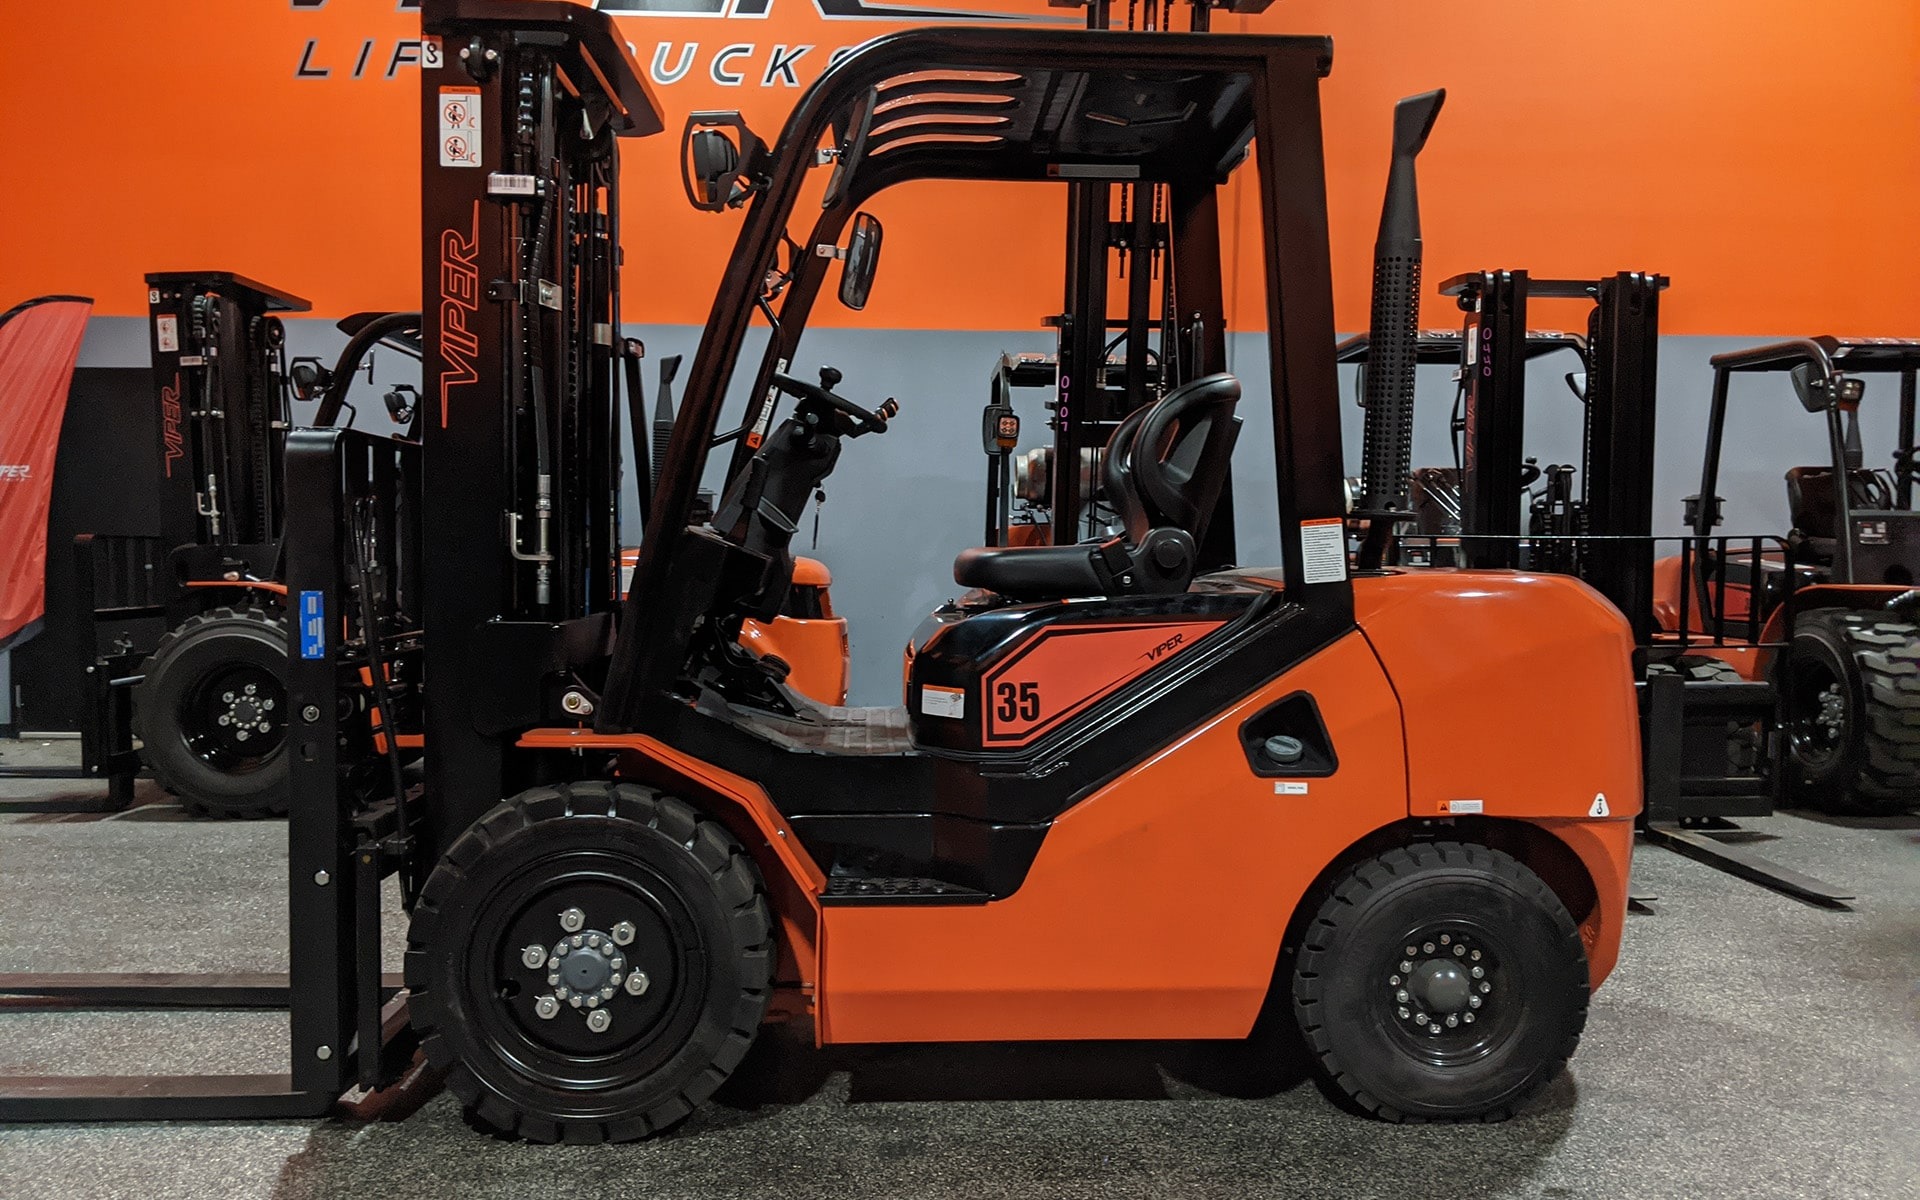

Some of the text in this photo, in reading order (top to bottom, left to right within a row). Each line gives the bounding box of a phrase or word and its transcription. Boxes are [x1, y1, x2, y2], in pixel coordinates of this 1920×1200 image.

[294, 37, 858, 88] LIF UCK
[440, 199, 479, 429] VIPER
[161, 371, 185, 478] VIPER
[1060, 375, 1070, 432] 0707
[0, 464, 33, 478] PER
[1136, 633, 1197, 661] VIPER
[997, 682, 1040, 722] 35
